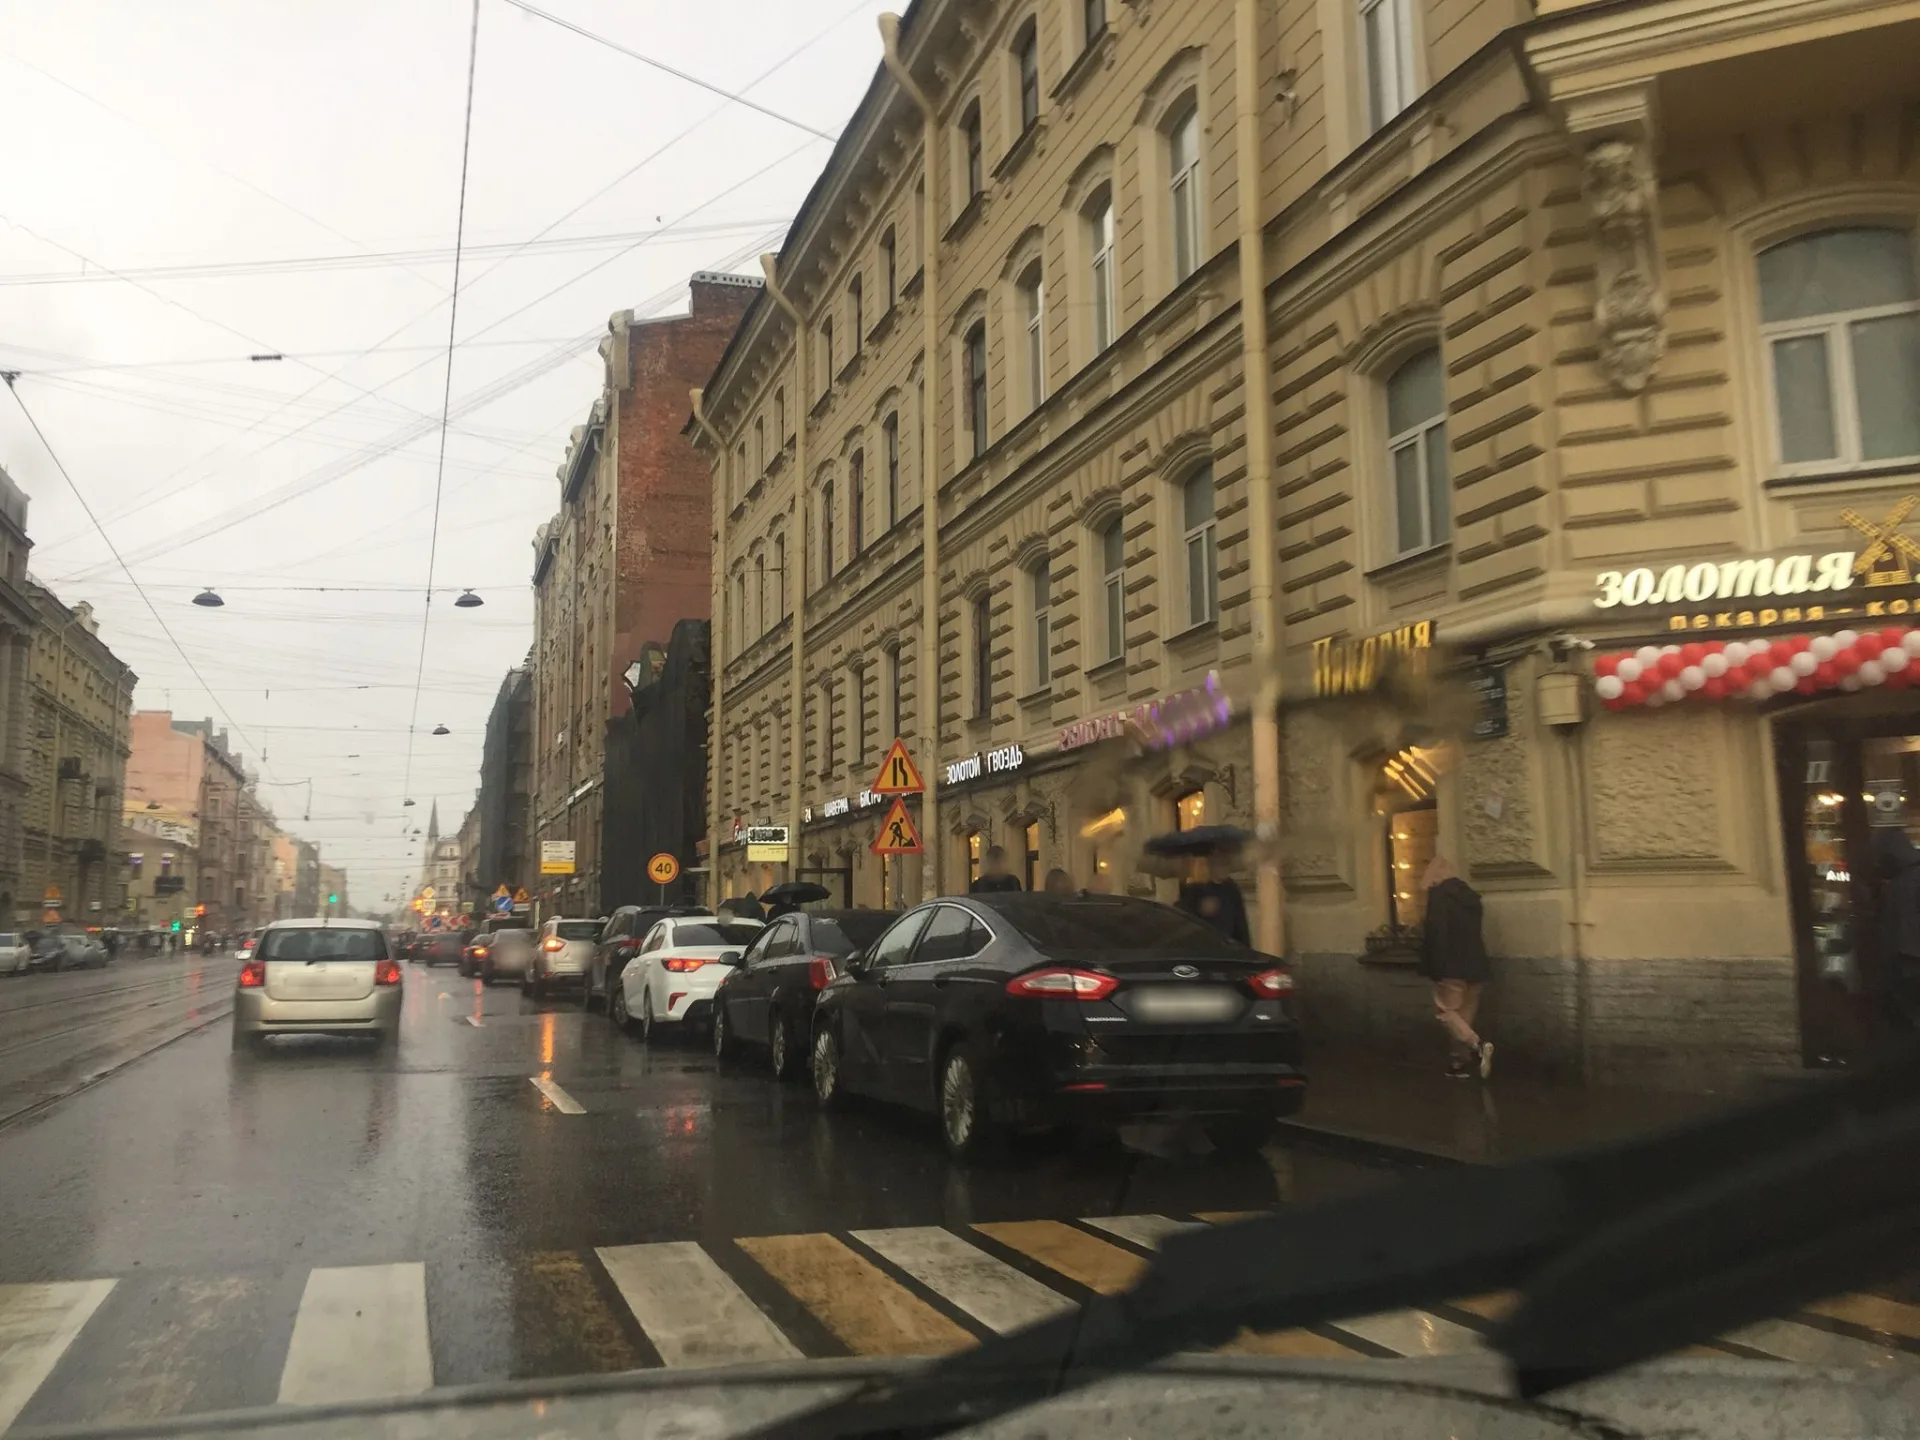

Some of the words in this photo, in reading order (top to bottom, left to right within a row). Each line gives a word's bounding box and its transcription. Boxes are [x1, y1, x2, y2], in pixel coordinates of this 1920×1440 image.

[1669, 606, 1825, 630] пекарня
[947, 753, 981, 785] ЗОЛОТОЙ
[987, 744, 1023, 773] ГВОЗДЬ
[655, 863, 672, 874] 40
